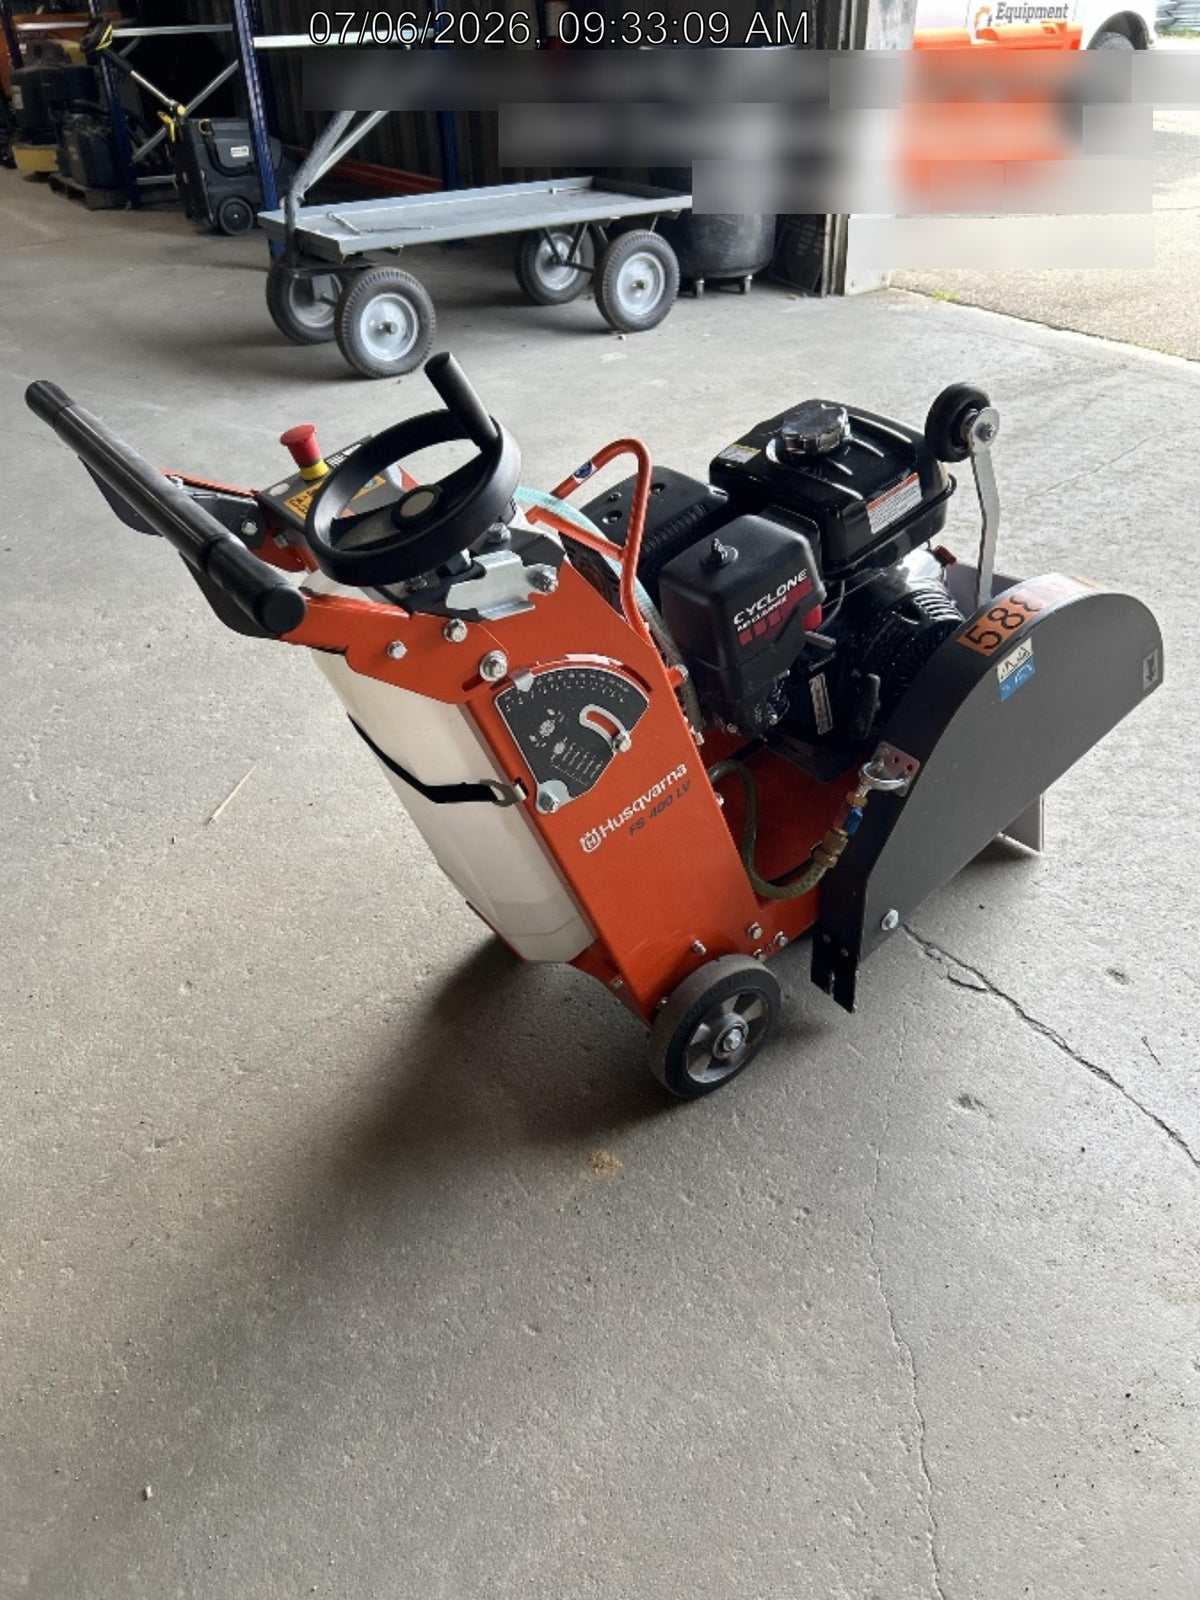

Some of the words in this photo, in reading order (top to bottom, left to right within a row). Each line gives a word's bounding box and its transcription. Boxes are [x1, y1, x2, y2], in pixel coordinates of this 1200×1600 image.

[995, 2, 1069, 23] Equipment
[734, 568, 807, 625] CYCLONE
[599, 763, 687, 838] Husqvarna
[629, 817, 645, 836] FS
[649, 794, 673, 818] 400
[676, 780, 691, 798] LV
